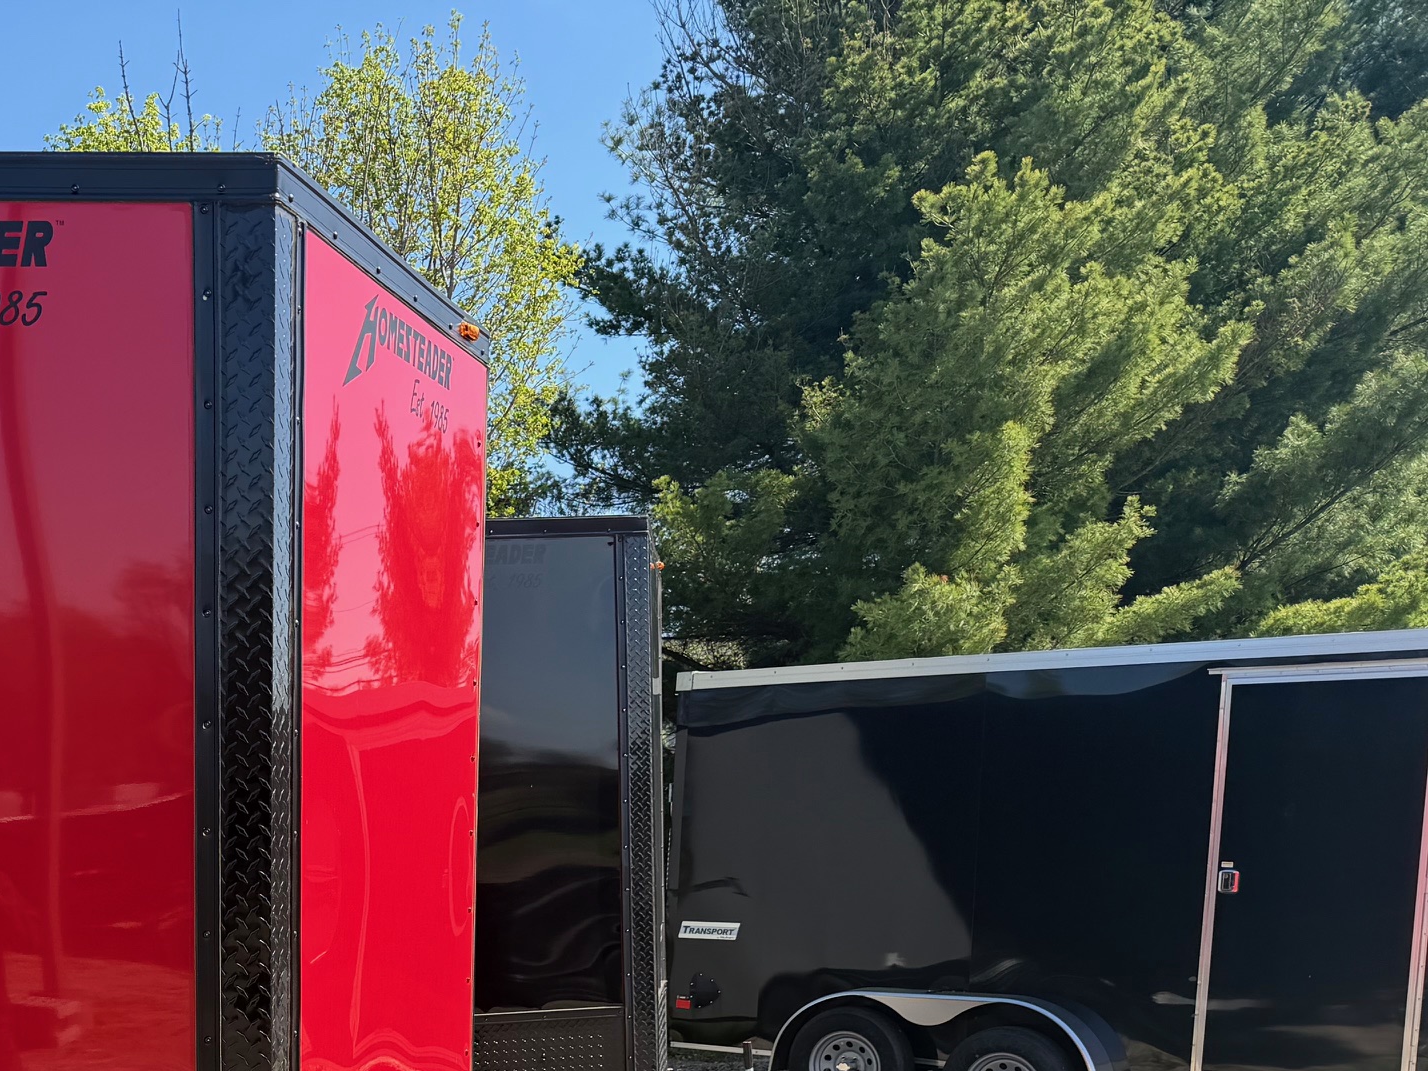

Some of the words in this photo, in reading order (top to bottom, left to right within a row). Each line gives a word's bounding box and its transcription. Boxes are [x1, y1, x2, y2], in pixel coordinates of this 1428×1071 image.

[342, 294, 453, 390] HOMESTEADER
[430, 400, 450, 434] 1985
[683, 925, 735, 935] TRANSPORT
